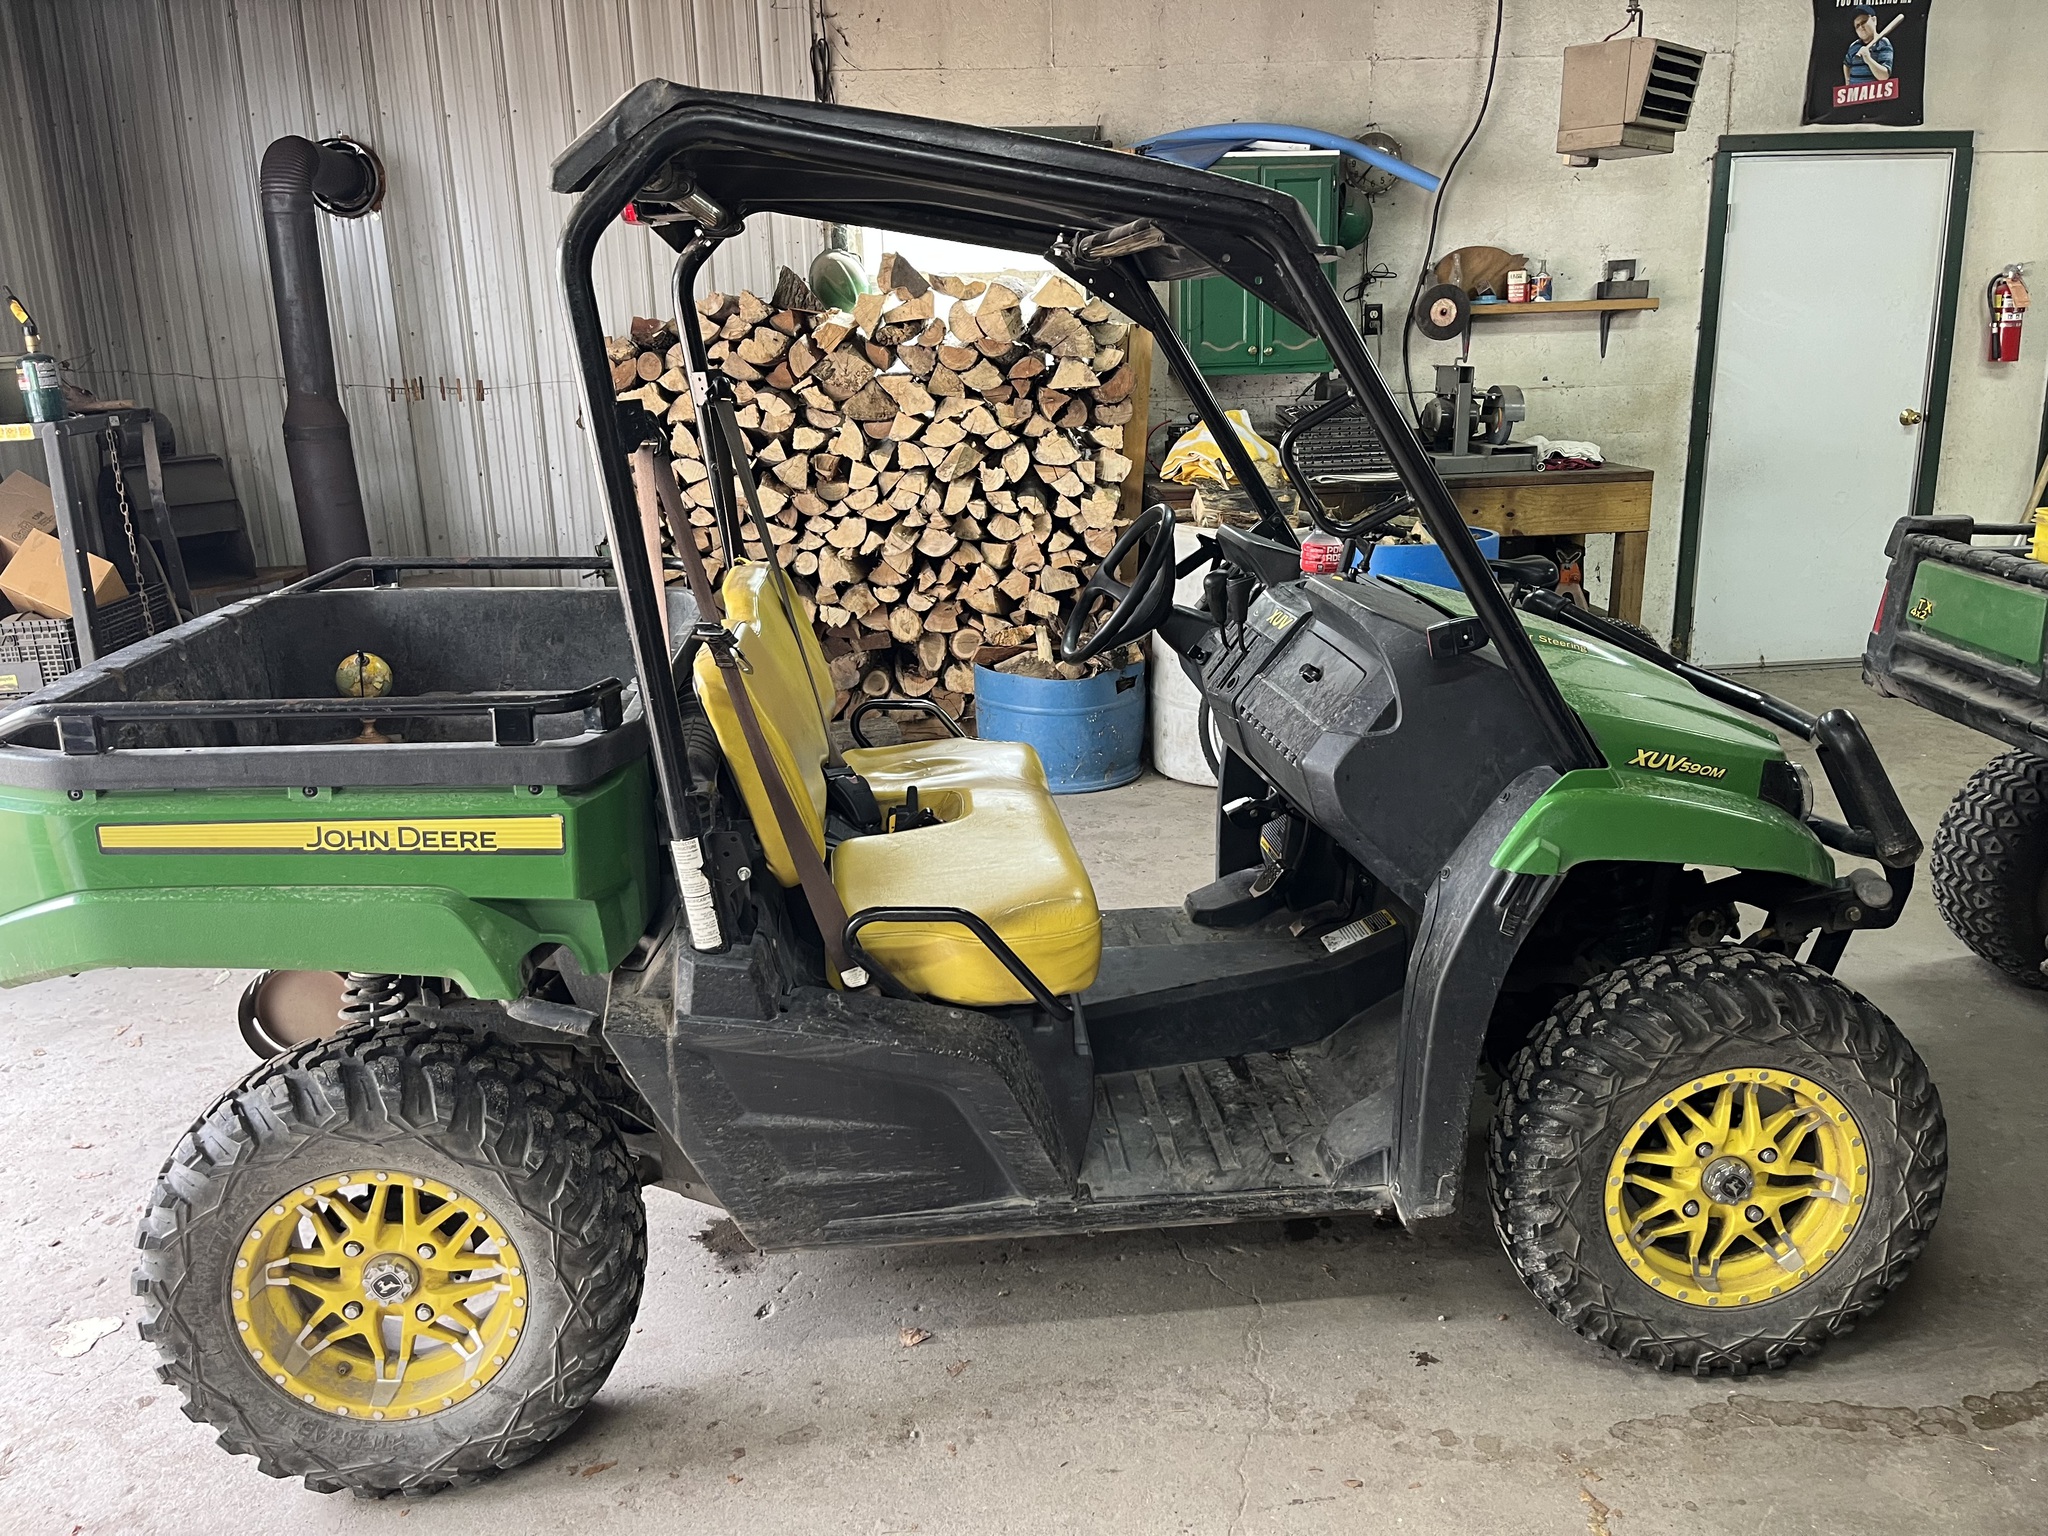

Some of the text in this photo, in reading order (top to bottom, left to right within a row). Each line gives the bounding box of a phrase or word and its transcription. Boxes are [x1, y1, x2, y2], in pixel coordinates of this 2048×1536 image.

[1836, 82, 1894, 104] SMALLS
[1919, 599, 1932, 613] TX
[1266, 607, 1295, 630] XUV
[1538, 634, 1588, 654] Steering
[1628, 748, 1727, 780] XUV590M
[306, 826, 499, 849] JOHN DEERE
[1780, 1049, 1860, 1100] TUSK
